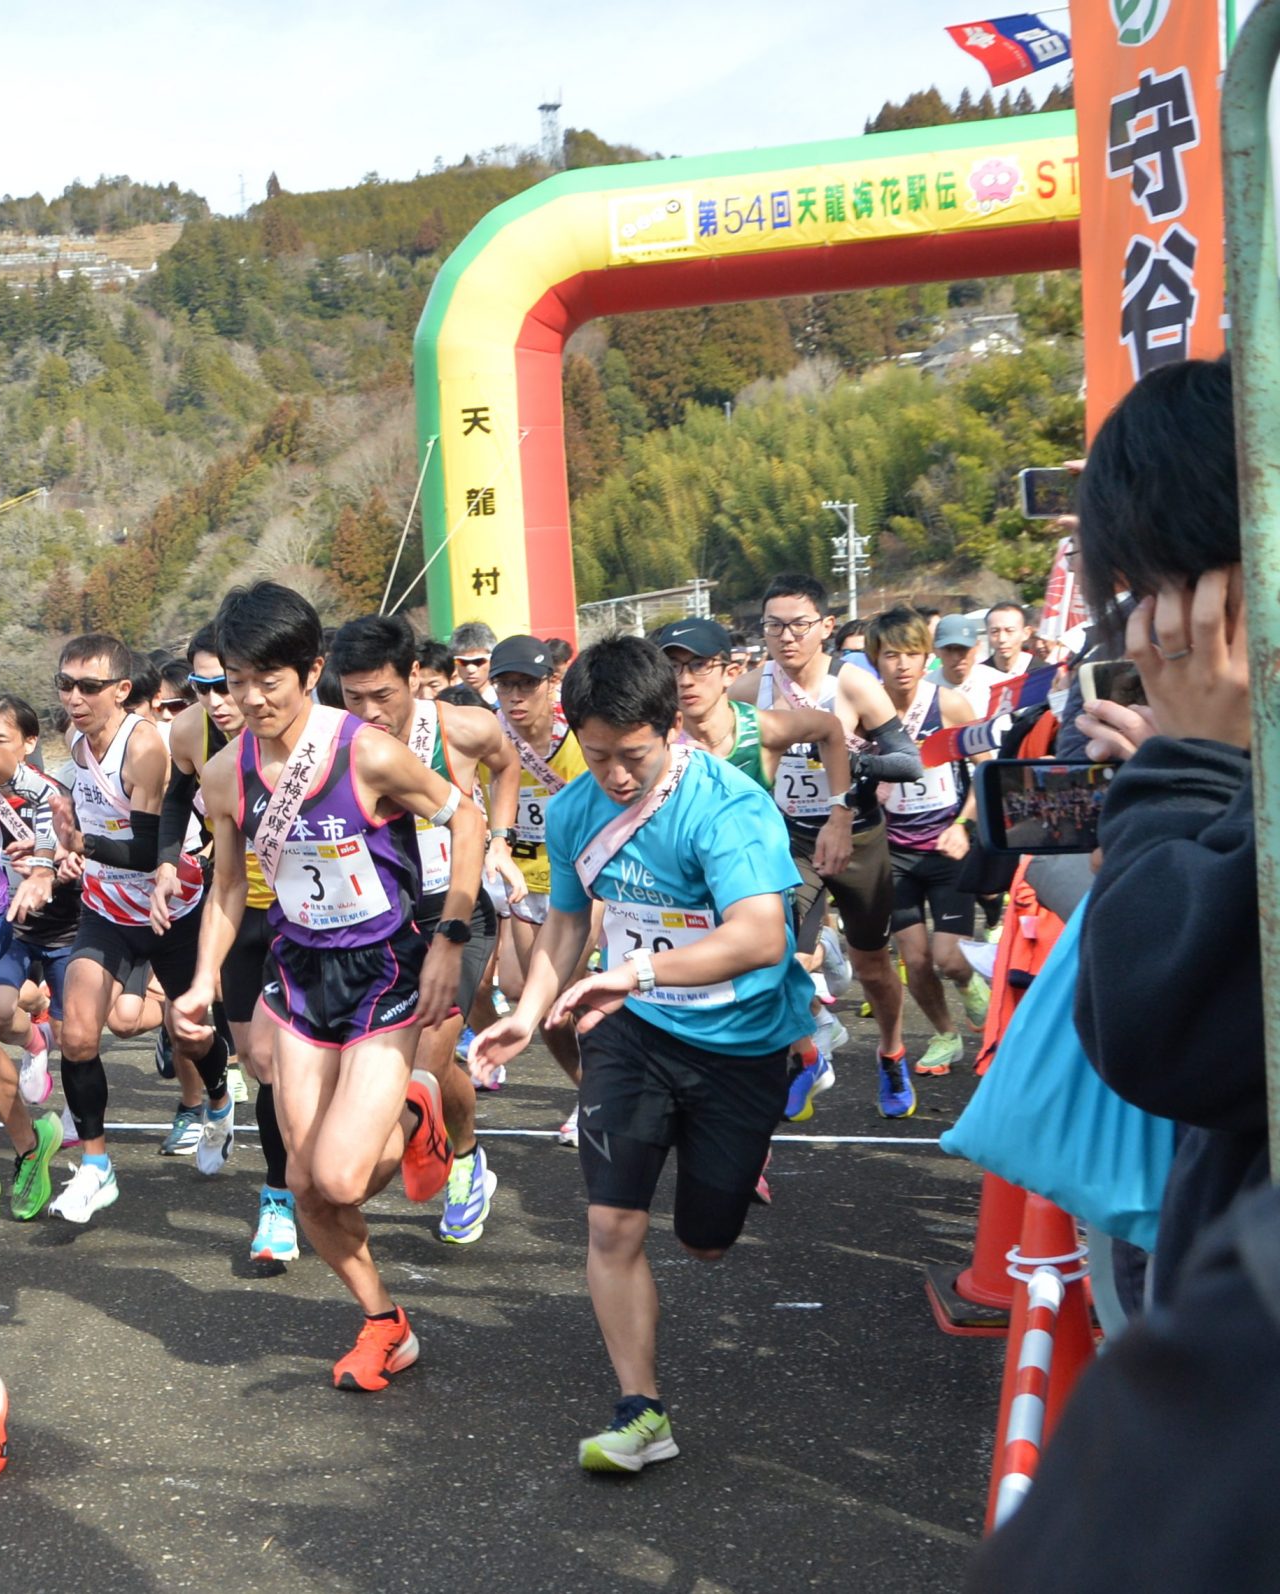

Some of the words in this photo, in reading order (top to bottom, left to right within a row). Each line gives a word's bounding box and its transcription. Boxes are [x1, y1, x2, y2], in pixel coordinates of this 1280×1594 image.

[1110, 69, 1198, 382] 守谷
[461, 407, 500, 597] 天龍村
[783, 774, 819, 799] 25
[527, 803, 544, 826] 8
[302, 864, 326, 902] 3
[349, 873, 363, 897] 1
[621, 859, 656, 888] We
[614, 879, 675, 908] Keep
